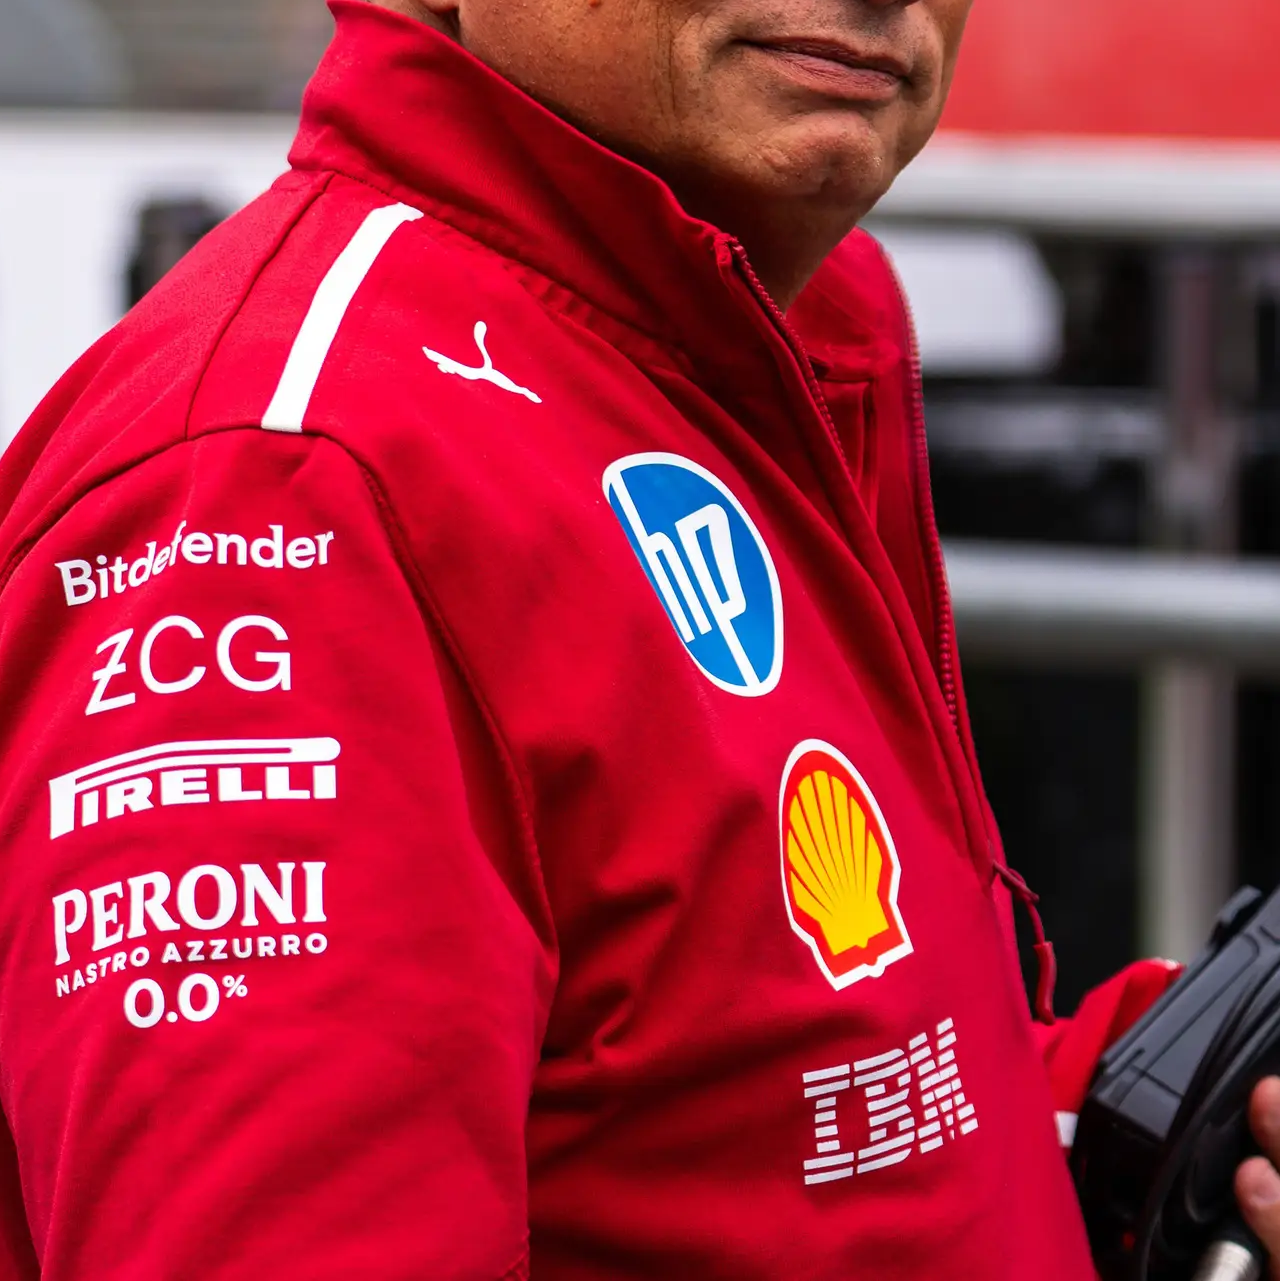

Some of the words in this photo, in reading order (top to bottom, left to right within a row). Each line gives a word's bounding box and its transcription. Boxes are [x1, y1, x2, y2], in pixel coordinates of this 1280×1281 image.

[54, 520, 335, 607] Bitdefender
[608, 466, 762, 688] hp
[84, 614, 292, 717] ZCG
[48, 736, 342, 840] PIRELLI
[52, 861, 328, 966] PERONI
[55, 946, 150, 998] NASTRO
[161, 932, 328, 964] AZZURRO
[802, 1017, 979, 1186] IBM
